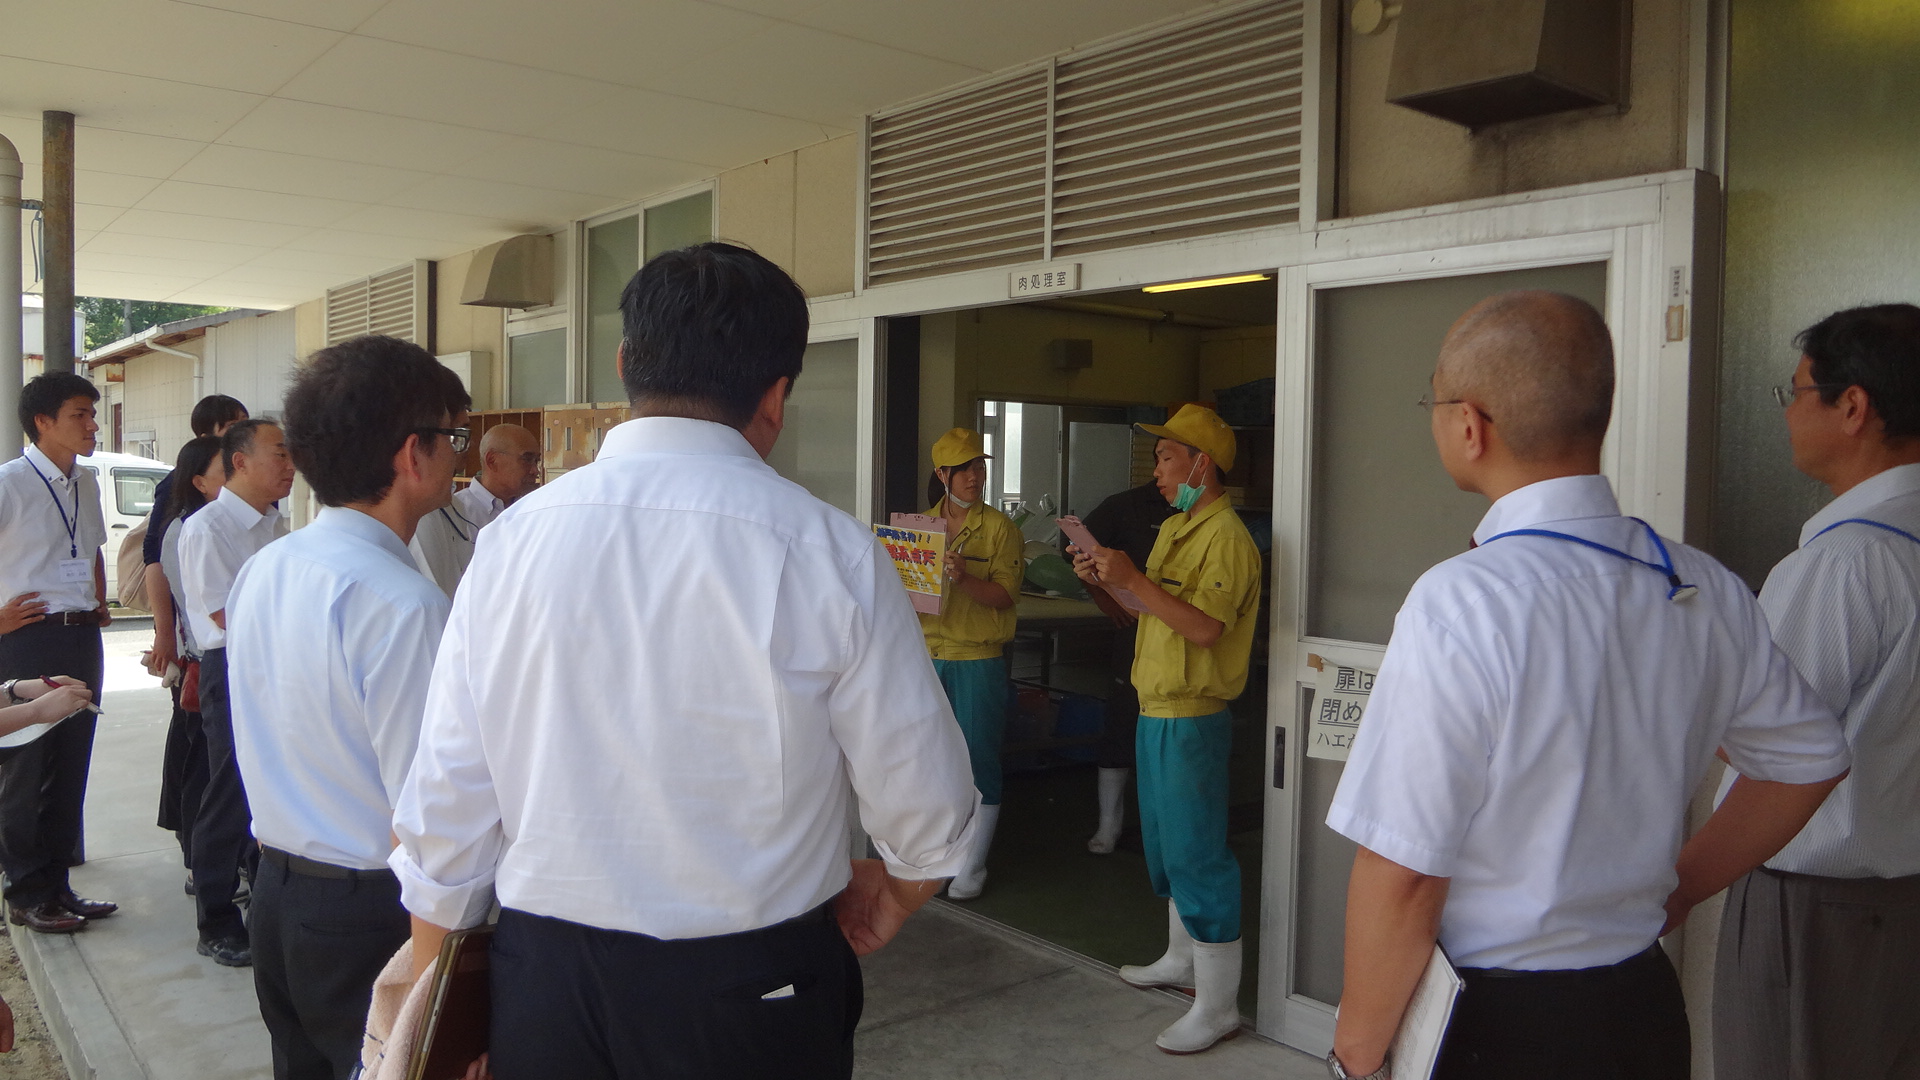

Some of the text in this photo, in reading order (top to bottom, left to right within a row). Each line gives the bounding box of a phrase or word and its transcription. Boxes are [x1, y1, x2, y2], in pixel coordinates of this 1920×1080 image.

[1018, 271, 1067, 291] 肉処理室
[1335, 666, 1377, 690] 扉は
[1320, 698, 1363, 722] 閉め
